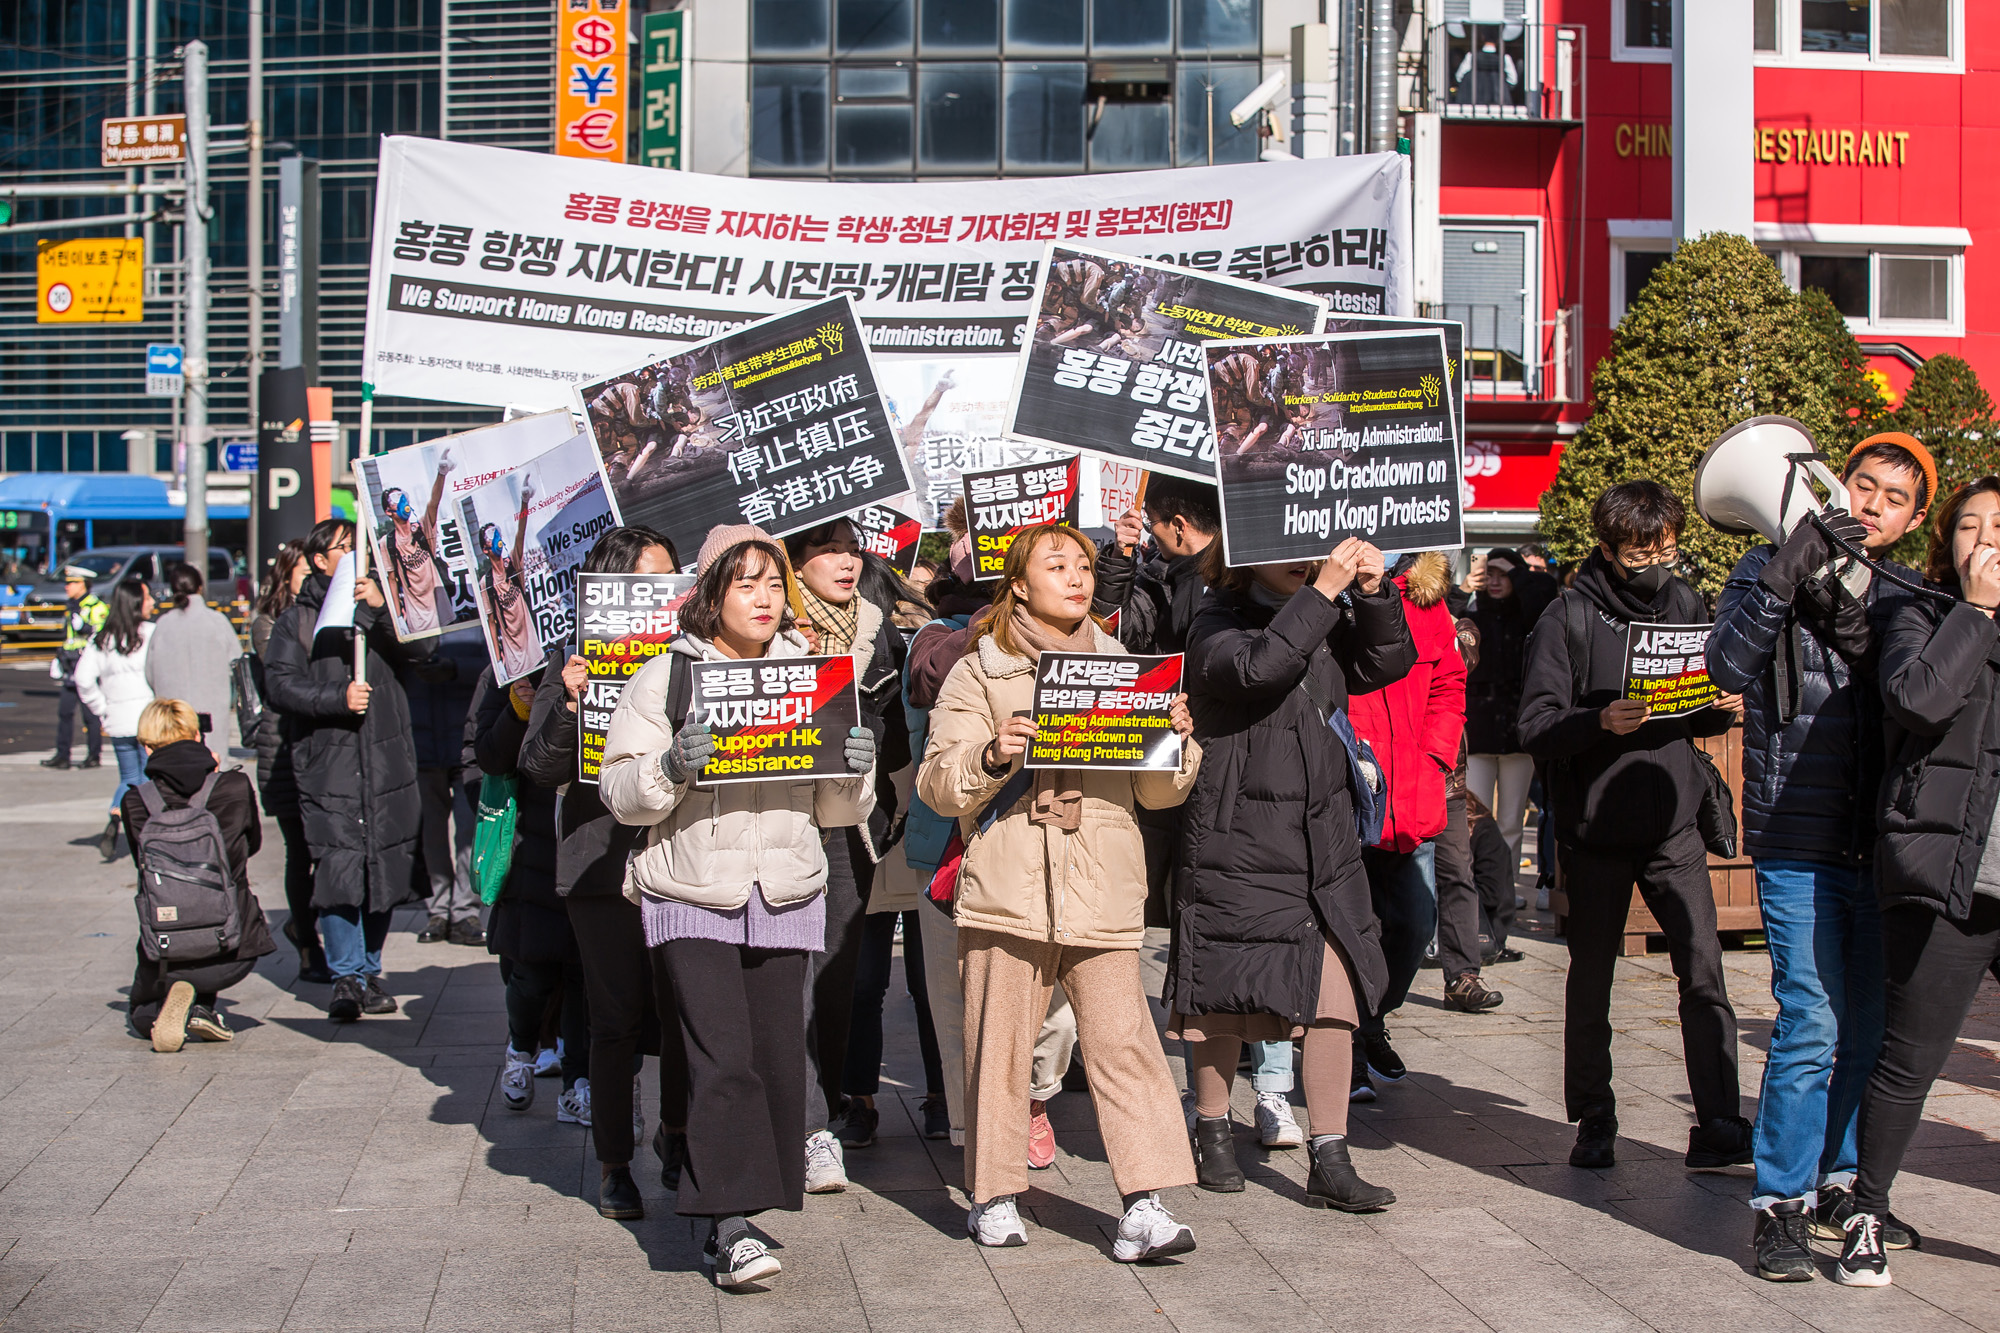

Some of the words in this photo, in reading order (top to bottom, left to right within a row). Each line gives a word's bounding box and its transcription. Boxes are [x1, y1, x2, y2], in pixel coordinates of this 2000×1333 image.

[106, 143, 179, 162] Myeongdong
[1615, 123, 1672, 157] CHIN
[564, 192, 622, 224] 홍콩
[626, 199, 712, 234] 항쟁을
[716, 210, 829, 242] 지지하는
[837, 215, 953, 243] 학생·청년
[957, 211, 1060, 242] 기자회견
[1064, 209, 1091, 239] 및
[1095, 199, 1233, 237] 홍보전(행진)
[392, 220, 474, 266] 홍콩
[480, 230, 563, 277] 항쟁
[566, 242, 743, 295] 지지한다!
[748, 260, 996, 303] 시진핑·캐리람
[1001, 260, 1040, 300] 정
[1226, 227, 1387, 282] 중단하라!
[400, 282, 432, 308] We
[434, 288, 516, 318] Support
[518, 297, 572, 324] Hong
[573, 303, 627, 330] Kong
[1154, 302, 1226, 328] 노동자연대
[377, 350, 415, 365] 공동주최:
[418, 355, 462, 369] 노동자연대
[506, 366, 578, 382] 사회변혁노동자당
[692, 336, 819, 392] 劳动者连带学生团体
[1154, 338, 1204, 371] 시진
[1053, 347, 1132, 396] 홍콩
[1130, 361, 1207, 413] 항쟁
[712, 373, 859, 444] 习近平政府
[950, 400, 1008, 413] 劳动者连带
[1283, 393, 1322, 405] Workers'
[1322, 392, 1361, 403] Solidarity
[1362, 389, 1398, 401] Students
[1398, 387, 1422, 400] Group
[727, 407, 875, 485] 停止镇压
[1130, 408, 1215, 463] 중단
[1302, 429, 1315, 451] Xi
[1316, 427, 1360, 453] JinPing
[1361, 421, 1443, 448] Administration!
[269, 467, 301, 510] P
[738, 454, 886, 526] 香港抗争
[970, 473, 1020, 504] 홍콩
[1022, 465, 1068, 496] 항쟁
[1285, 462, 1326, 499] Stop
[1329, 456, 1424, 491] Crackdown
[1427, 459, 1447, 484] on
[537, 490, 566, 509] Solidarity
[564, 477, 588, 496] Students
[862, 507, 896, 533] 요구
[973, 493, 1066, 531] 지지한다!
[1283, 503, 1331, 539] Hong
[1334, 498, 1378, 536] Kong
[1381, 494, 1450, 528] Protests
[547, 530, 571, 555] We
[572, 510, 614, 543] Suppo
[859, 529, 899, 561] 하라!
[977, 534, 1018, 552] Sup
[979, 555, 1005, 572] Re
[584, 581, 626, 606] 5대
[630, 582, 677, 607] 요구
[538, 607, 577, 645] Res
[583, 610, 683, 636] 수용하라
[583, 639, 626, 656] Five
[629, 640, 671, 656] Dem
[584, 660, 619, 676] Not
[621, 662, 645, 676] on
[1042, 659, 1140, 687] 시진핑은
[1632, 656, 1685, 675] 탄압을
[1686, 655, 1706, 673] 중
[700, 667, 755, 698] 홍콩
[759, 664, 818, 695] 항쟁
[1629, 678, 1640, 690] Xi
[1642, 678, 1677, 691] JinPing
[1678, 674, 1710, 687] Admini
[1654, 687, 1708, 702] Crackdown
[703, 696, 813, 728] 지지한다!
[1039, 689, 1096, 709] 탄압을
[1652, 702, 1677, 713] Kong
[1037, 714, 1048, 727] Xi
[1050, 714, 1087, 729] JinPing
[583, 732, 593, 745] Xi
[594, 734, 607, 746] Jin
[711, 730, 788, 754] Support
[791, 728, 822, 747] HK
[1035, 730, 1061, 744] Stop
[1063, 730, 1126, 743] Crackdown
[1128, 733, 1143, 743] on
[583, 762, 600, 775] Hon
[704, 754, 814, 776] Resistance
[1032, 746, 1062, 761] Hong
[1063, 746, 1091, 762] Kong
[1093, 747, 1144, 760] Protests
